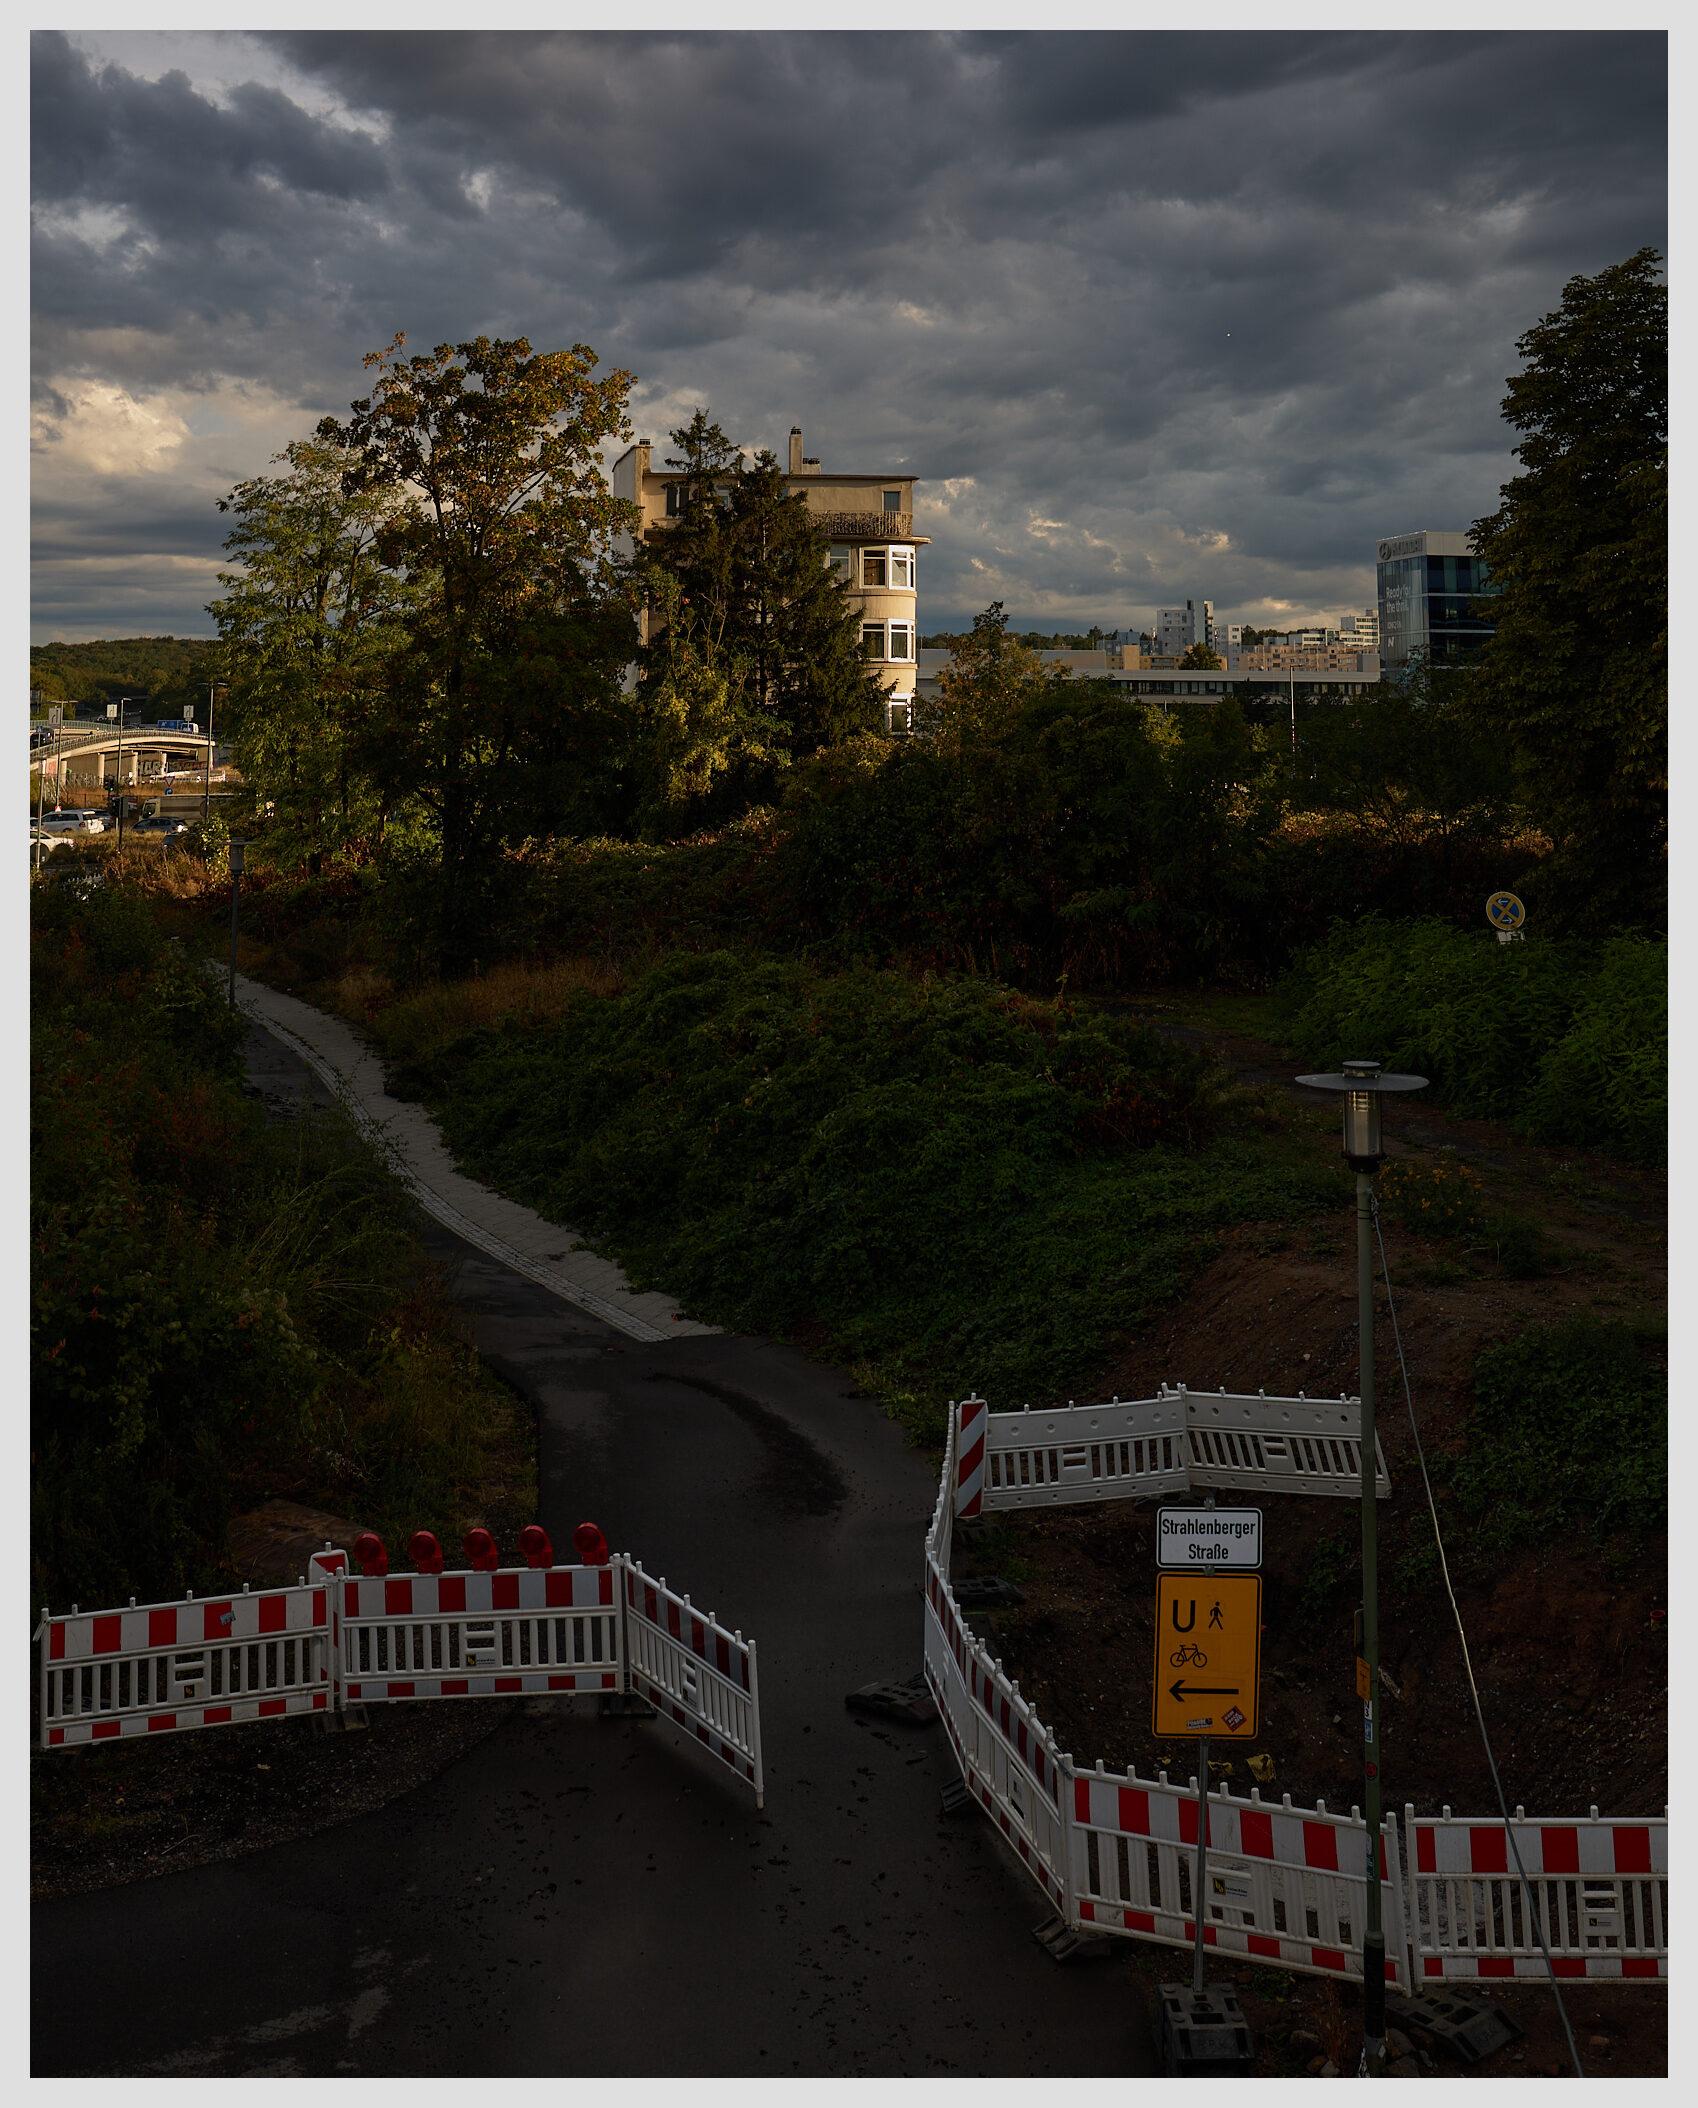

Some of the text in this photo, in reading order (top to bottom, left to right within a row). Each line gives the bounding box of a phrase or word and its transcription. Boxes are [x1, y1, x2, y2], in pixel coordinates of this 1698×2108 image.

[1162, 1518, 1256, 1539] Strahlenberger
[1188, 1543, 1229, 1560] Straße
[1172, 1599, 1196, 1633] U
